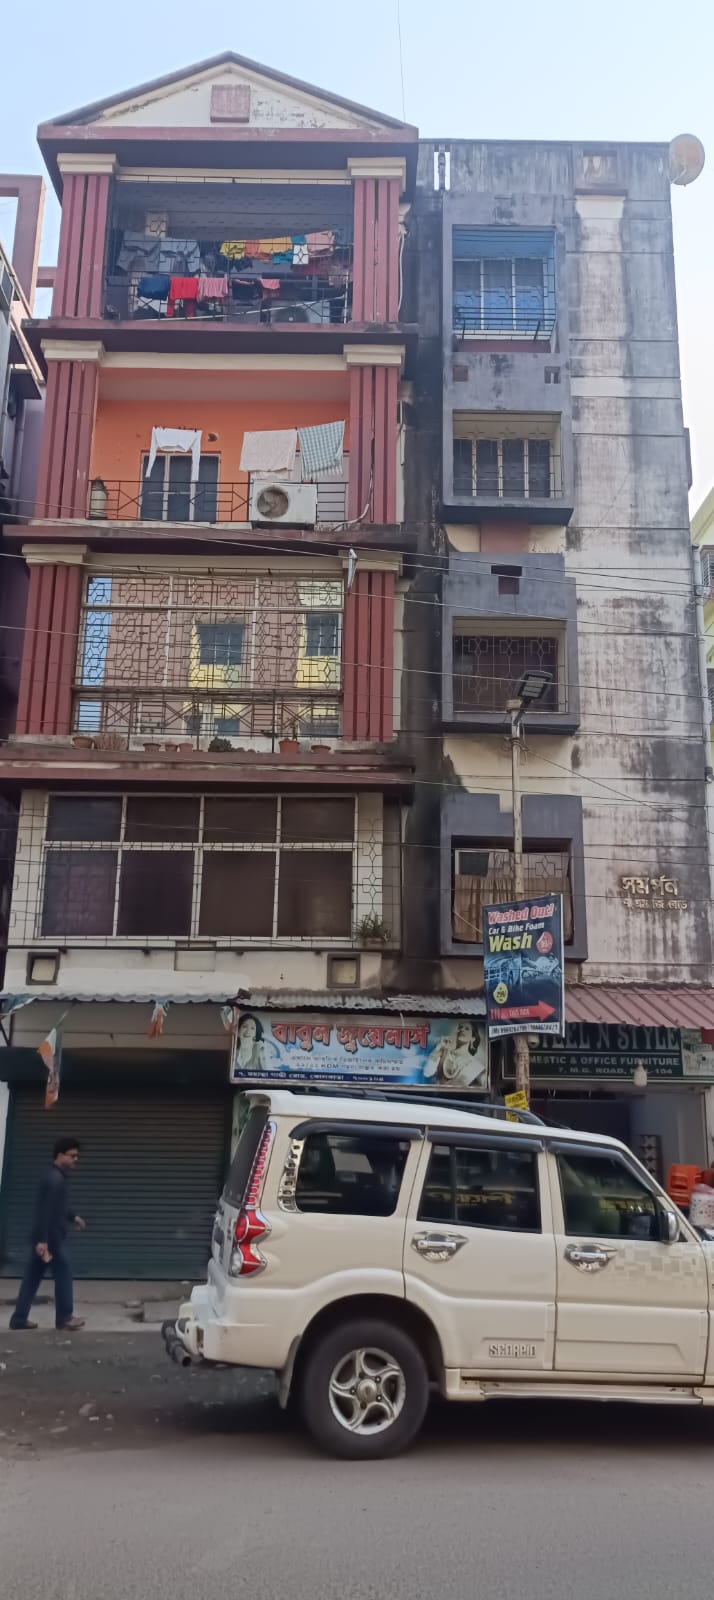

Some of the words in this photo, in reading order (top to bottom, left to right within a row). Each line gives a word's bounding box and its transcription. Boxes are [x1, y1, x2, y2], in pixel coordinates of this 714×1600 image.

[621, 875, 679, 896] সমর্পন
[488, 908, 529, 925] Washed
[530, 903, 555, 920] Out!
[488, 927, 500, 935] Car
[507, 923, 524, 932] Bike
[525, 921, 545, 931] Foam
[488, 932, 533, 953] Wash
[271, 1022, 331, 1052] বাবুল
[617, 1026, 680, 1051] STYLE
[570, 1056, 577, 1064] &
[580, 1056, 617, 1065] OFFICE
[620, 1056, 680, 1066] FURNITURE
